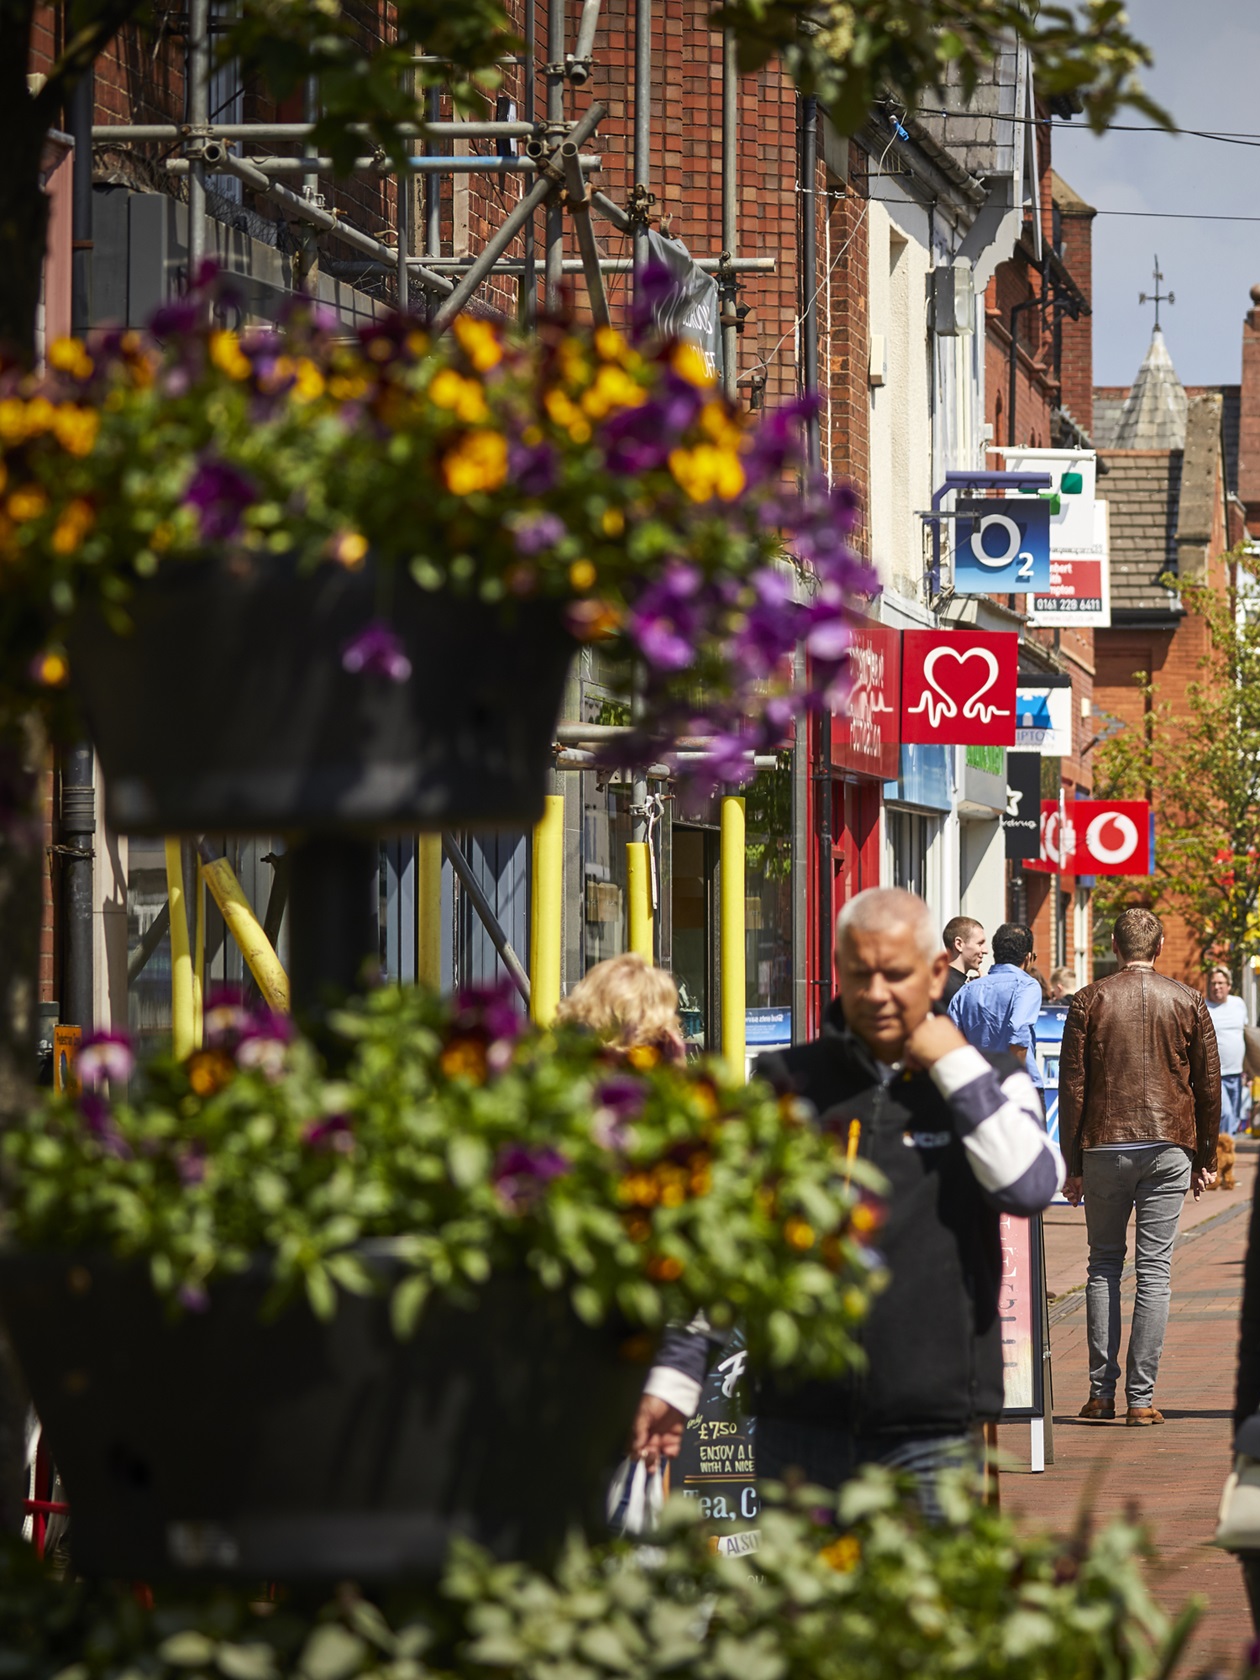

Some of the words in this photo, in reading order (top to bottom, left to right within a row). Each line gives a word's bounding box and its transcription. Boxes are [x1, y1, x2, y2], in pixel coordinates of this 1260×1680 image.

[971, 514, 1034, 576] O2
[1036, 598, 1057, 611] 0161
[1060, 598, 1077, 611] 228
[1079, 598, 1101, 611] 6411
[700, 1444, 735, 1460] ENJOY
[737, 1444, 745, 1460] A
[700, 1461, 722, 1473] WITH
[724, 1460, 732, 1473] A
[735, 1460, 755, 1472] NICE
